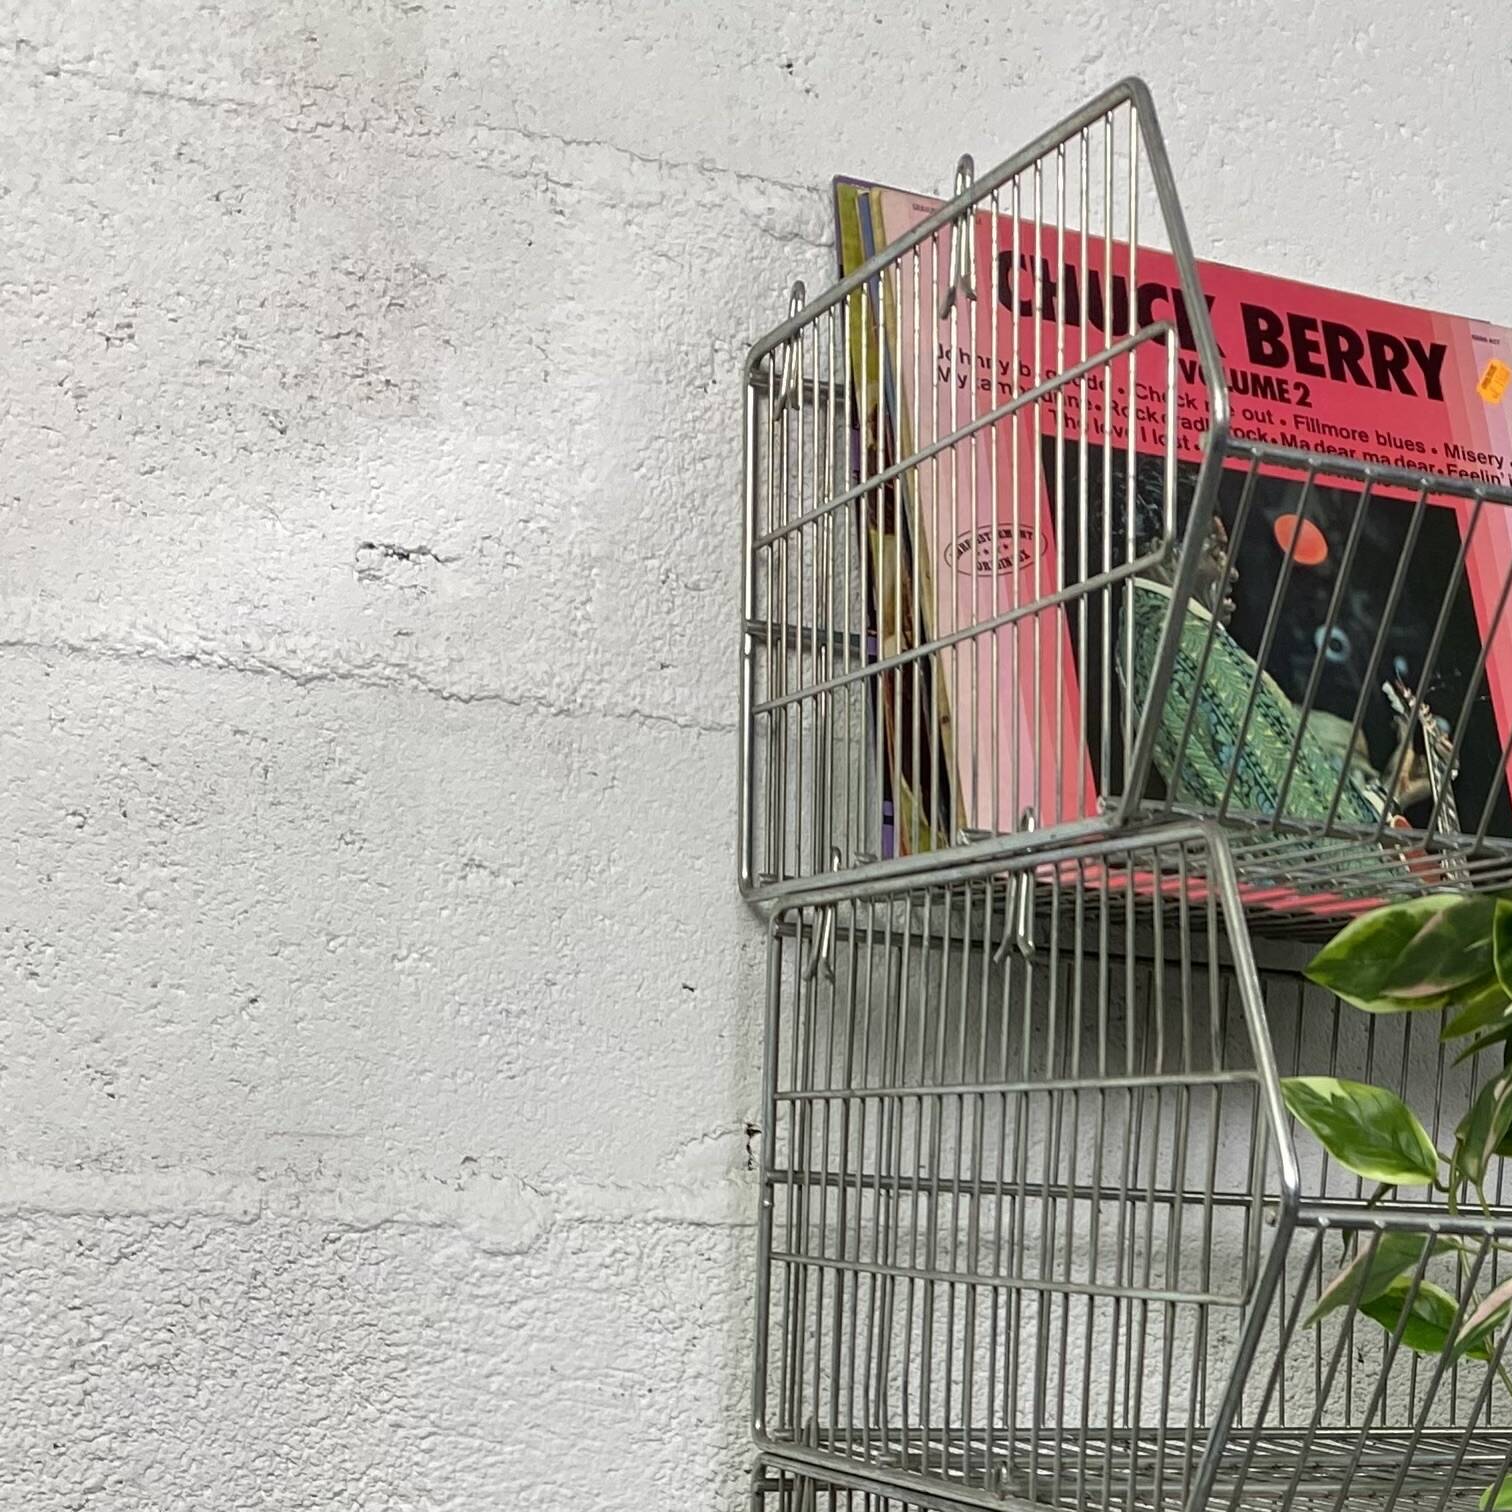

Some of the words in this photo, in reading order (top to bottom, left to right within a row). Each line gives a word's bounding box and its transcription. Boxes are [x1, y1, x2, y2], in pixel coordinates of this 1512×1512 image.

[1239, 302, 1448, 402] BERRY
[1241, 408, 1275, 425] out
[1293, 414, 1370, 443] Fillmore
[1375, 430, 1426, 454] blues
[1443, 442, 1504, 469] Misery
[1280, 432, 1310, 451] Ma
